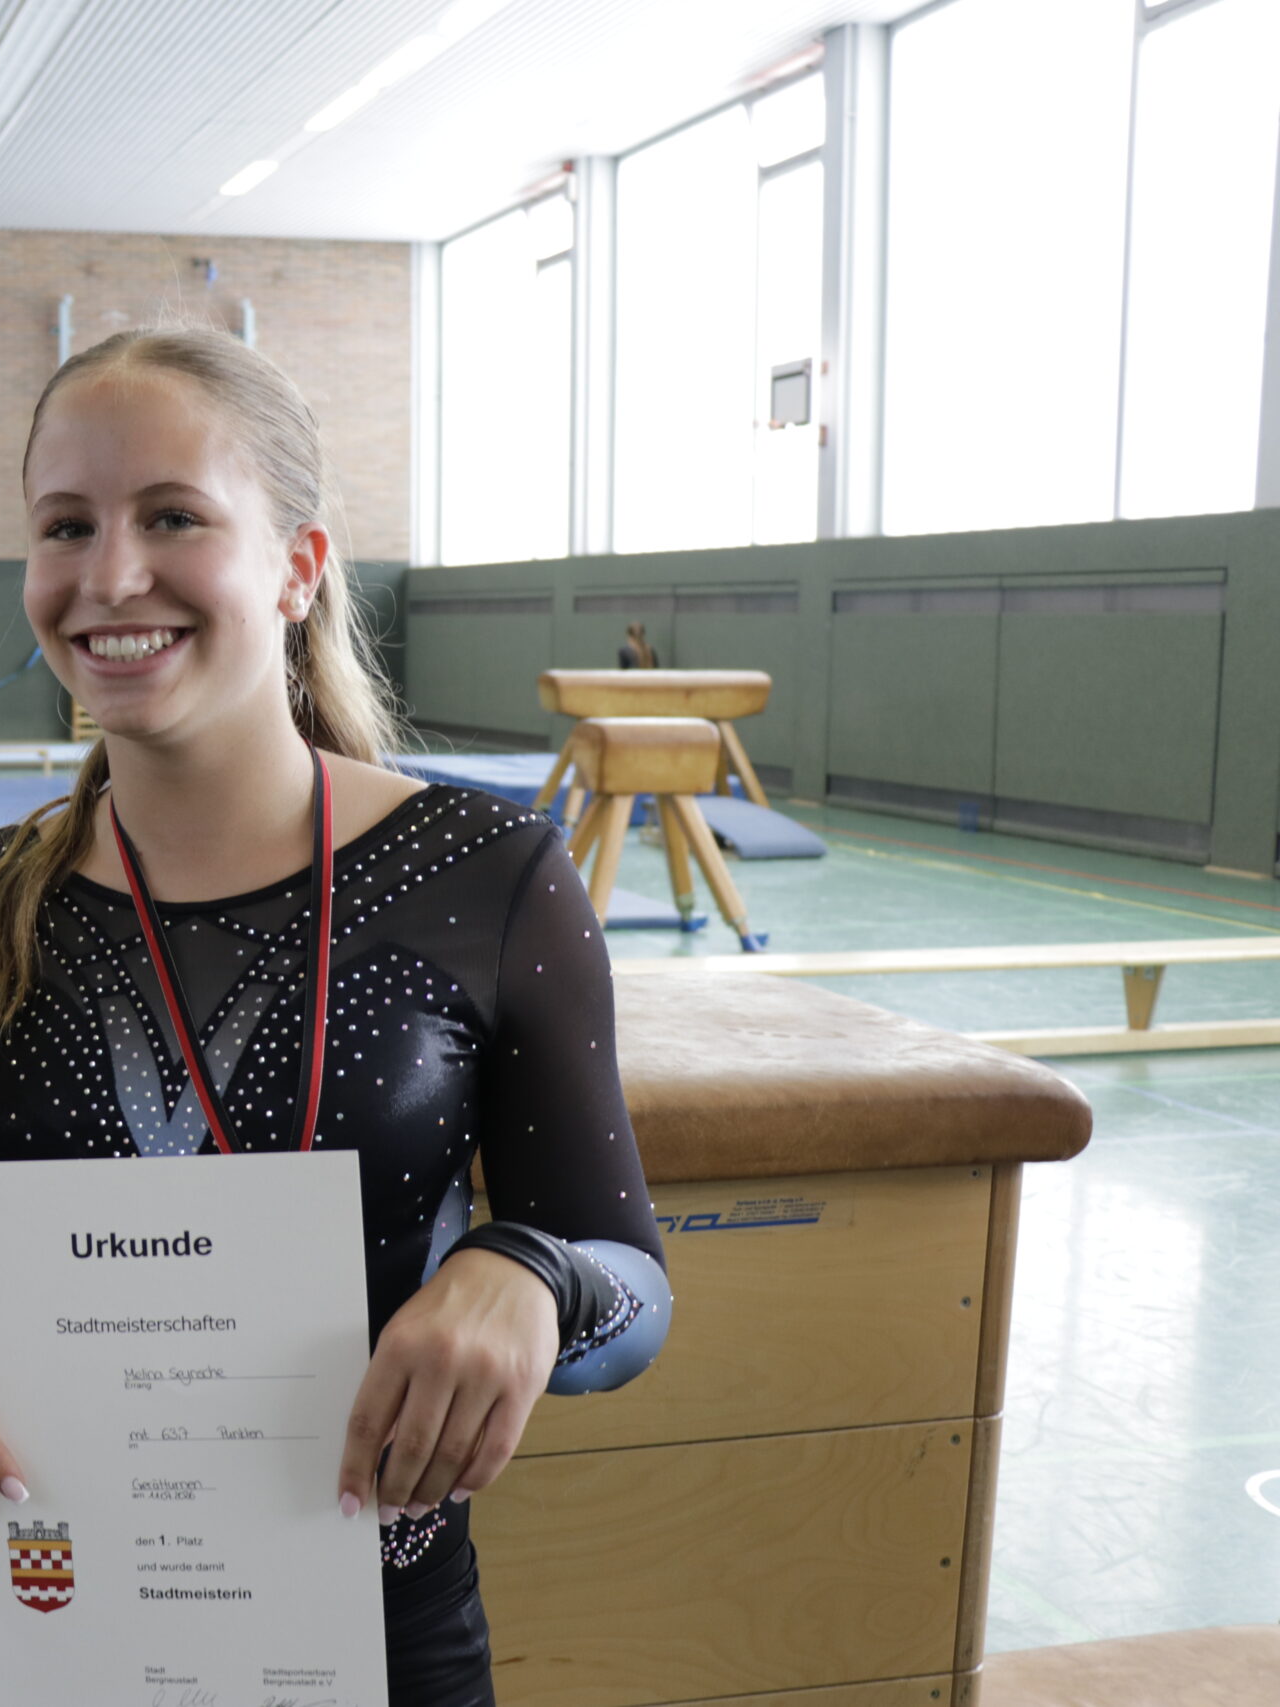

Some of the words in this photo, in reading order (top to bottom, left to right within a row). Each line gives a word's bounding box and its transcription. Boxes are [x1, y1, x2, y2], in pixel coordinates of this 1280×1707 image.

[71, 1230, 213, 1259] Urkunde
[56, 1315, 237, 1335] Stadtmeisterschaften
[135, 1536, 155, 1546] den
[176, 1535, 203, 1546] Platz
[137, 1562, 157, 1571] und
[160, 1562, 192, 1571] wurde
[195, 1561, 225, 1571] damit
[139, 1587, 252, 1600] Stadtmeisterin
[145, 1666, 165, 1674] Stadt
